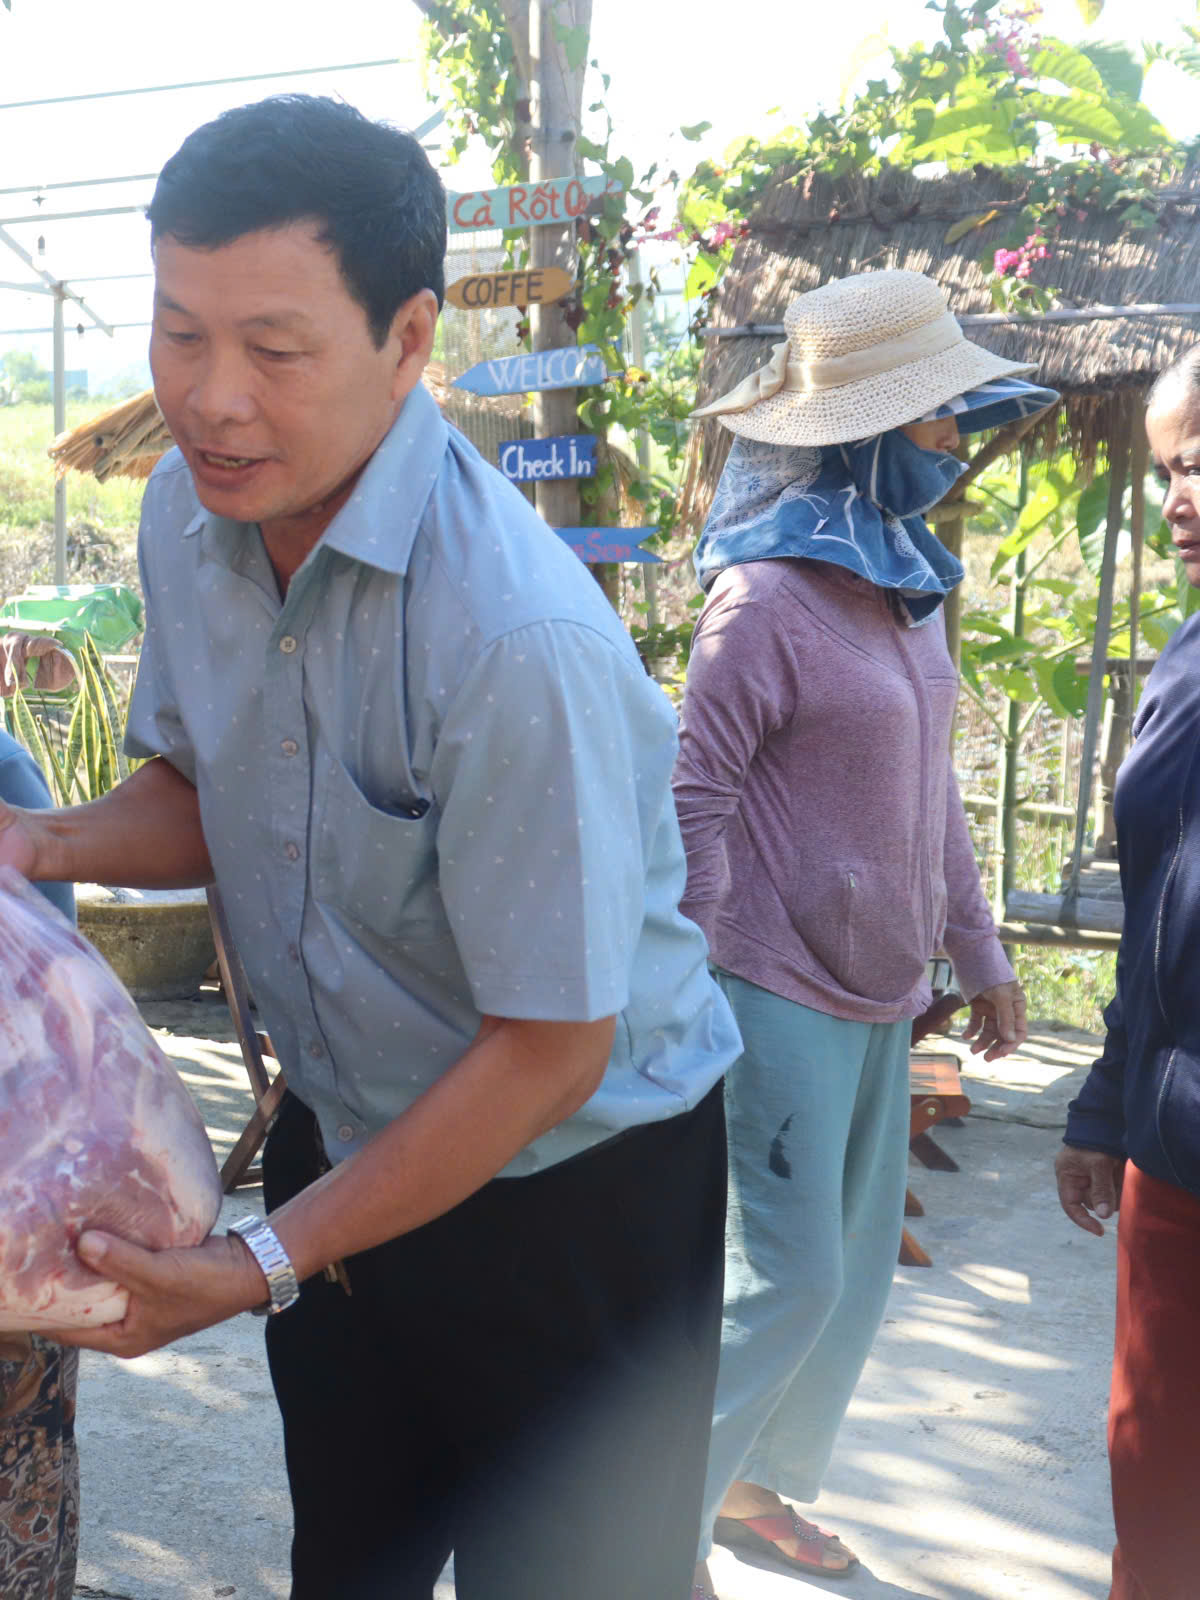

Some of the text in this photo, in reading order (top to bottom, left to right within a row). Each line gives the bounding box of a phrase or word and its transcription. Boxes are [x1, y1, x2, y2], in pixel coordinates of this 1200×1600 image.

[453, 192, 495, 228] Cà
[508, 182, 561, 225] Rốt
[462, 272, 545, 306] COFFE
[502, 443, 564, 480] Check
